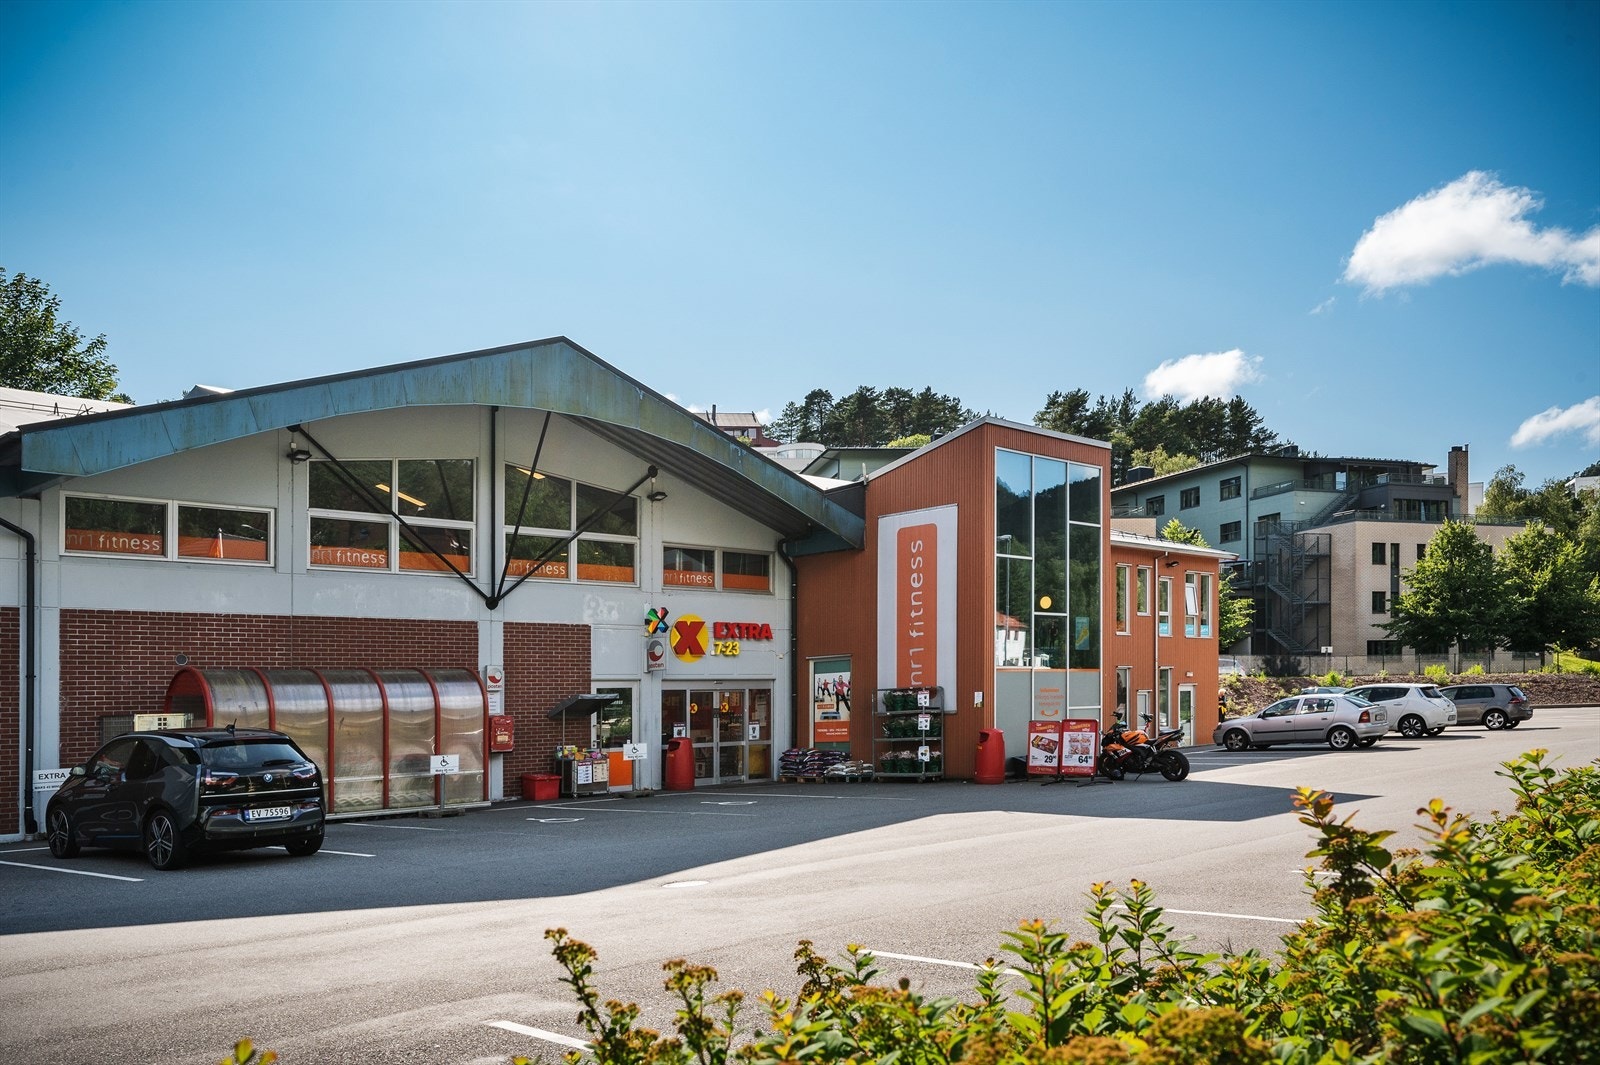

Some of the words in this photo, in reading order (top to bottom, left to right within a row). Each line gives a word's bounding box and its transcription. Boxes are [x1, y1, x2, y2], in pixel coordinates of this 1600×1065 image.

[98, 534, 161, 551] fitness
[336, 550, 386, 564] fitness
[679, 571, 713, 584] fitness
[909, 539, 925, 638] fitness
[713, 621, 774, 640] EXTRA
[714, 641, 740, 656] 7-23
[909, 647, 925, 686] nr1
[38, 772, 67, 780] EXTRA
[251, 810, 262, 818] EV
[264, 807, 289, 817] 75596
